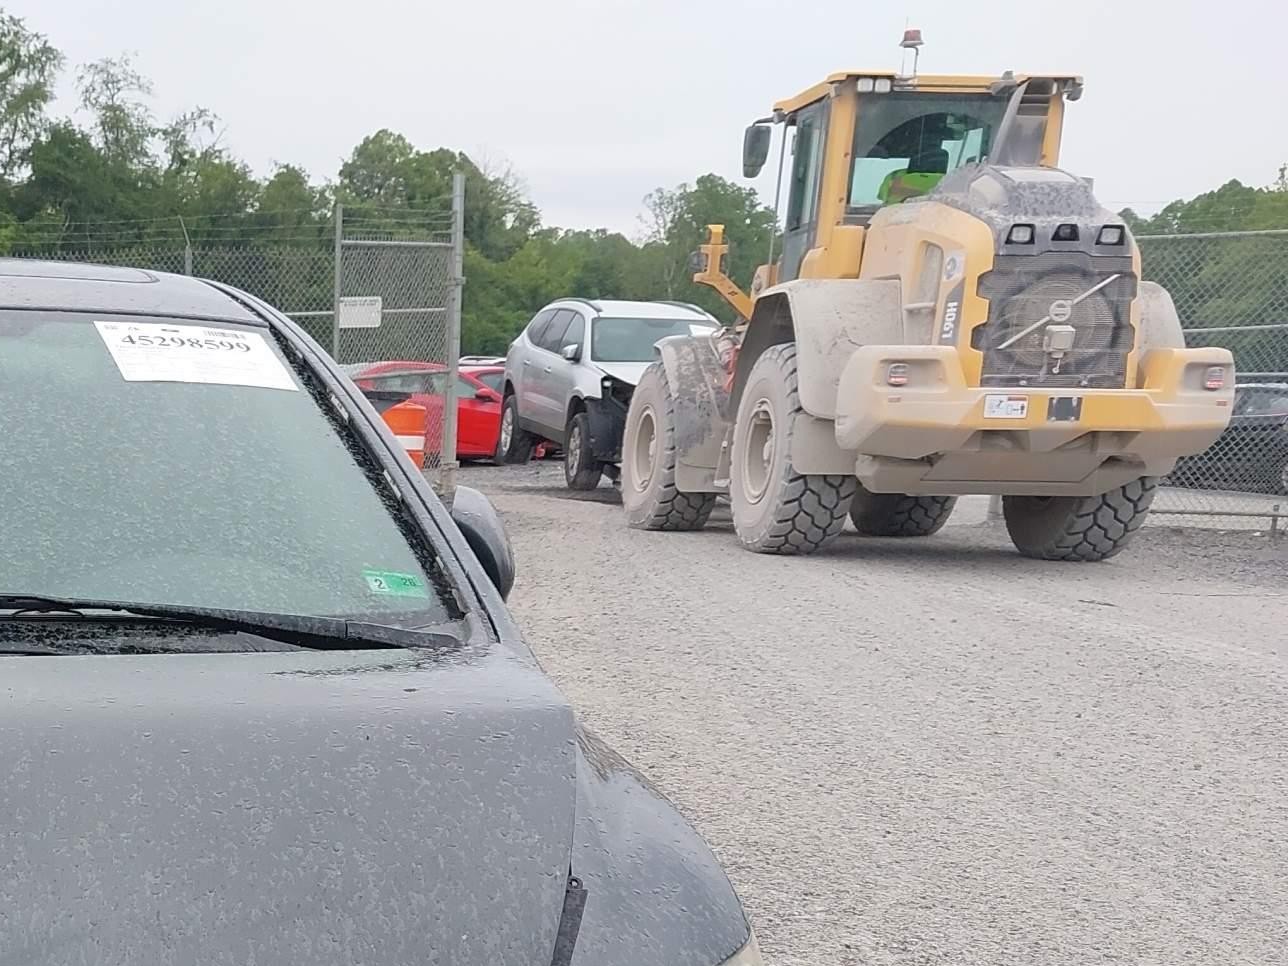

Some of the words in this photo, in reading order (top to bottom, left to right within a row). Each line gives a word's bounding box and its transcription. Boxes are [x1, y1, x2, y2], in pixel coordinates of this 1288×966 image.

[941, 301, 959, 339] L90H
[121, 334, 251, 353] 45298599
[373, 578, 387, 590] 2
